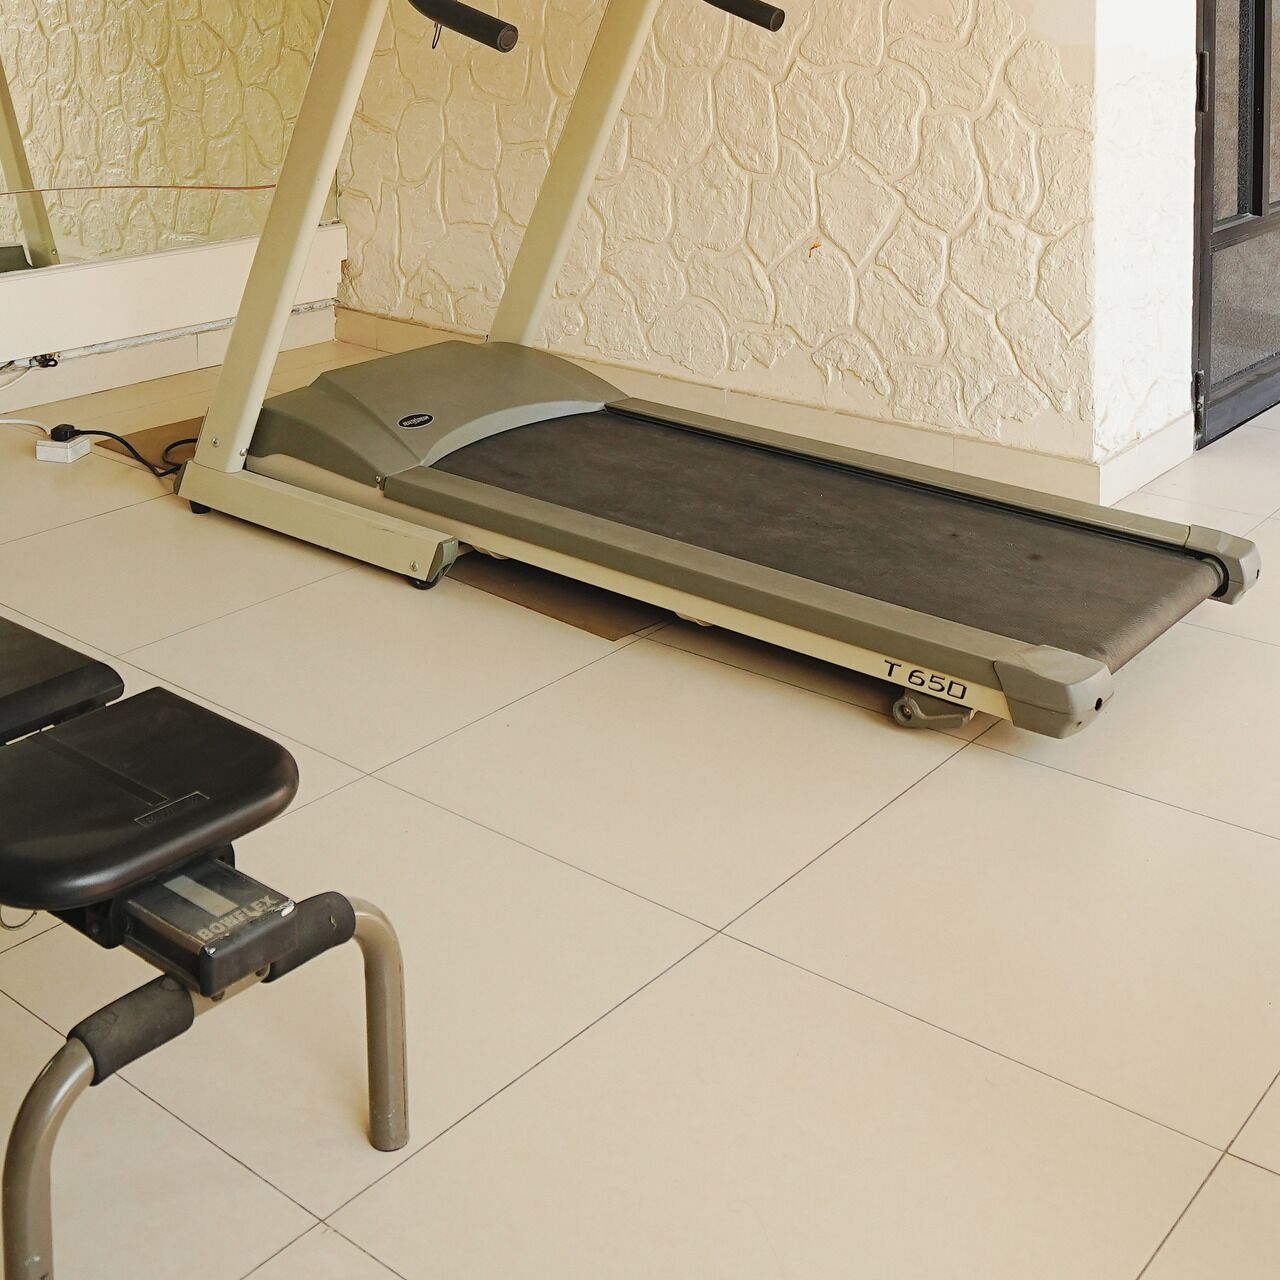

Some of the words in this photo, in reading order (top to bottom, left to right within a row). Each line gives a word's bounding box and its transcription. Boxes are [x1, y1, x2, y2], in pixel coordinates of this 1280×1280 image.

[884, 659, 902, 677] T
[908, 669, 967, 700] 650
[196, 895, 278, 941] BOWFLEX
